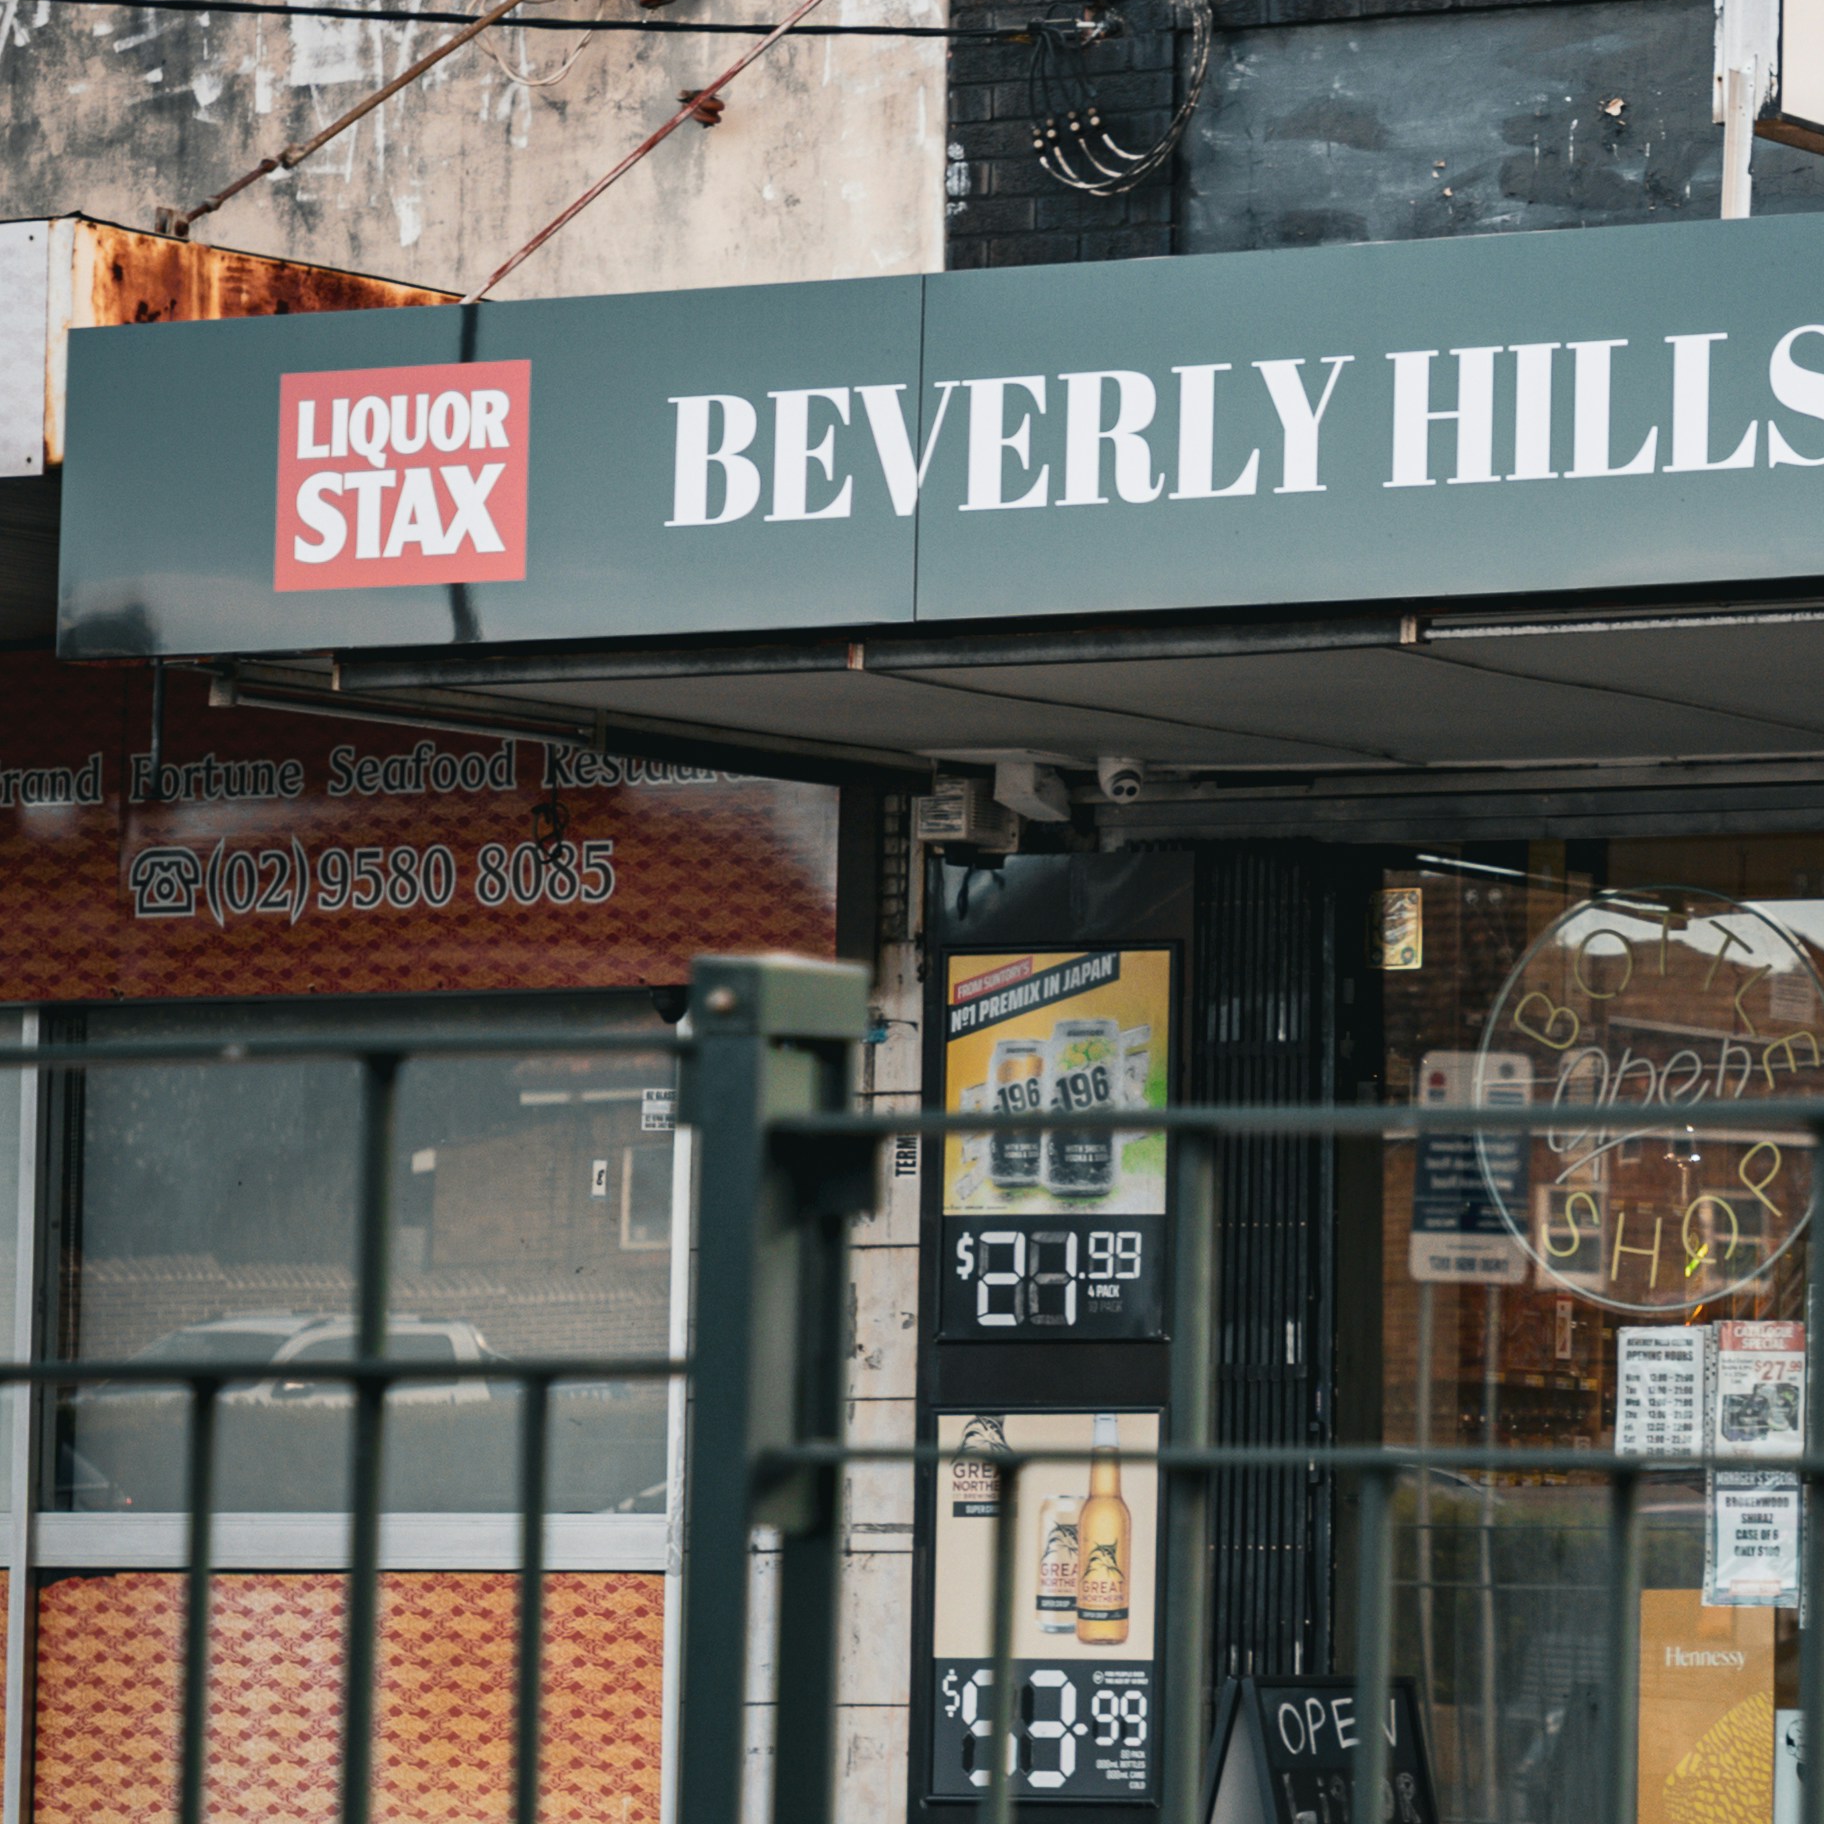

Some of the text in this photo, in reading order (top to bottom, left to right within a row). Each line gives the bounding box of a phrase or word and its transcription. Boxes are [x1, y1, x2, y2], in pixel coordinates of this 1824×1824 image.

[297, 389, 510, 469] LIQUOR
[664, 355, 1355, 527] BEVERLY
[294, 462, 507, 564] STAX
[328, 740, 517, 796] Seafood
[475, 840, 615, 906] 8085
[979, 979, 1041, 1022] PREMIX
[1043, 973, 1060, 999] IN
[1096, 1285, 1120, 1298] PACK
[1735, 1529, 1759, 1540] CASE
[1082, 1581, 1124, 1593] GREAT
[1665, 1646, 1745, 1671] Hennessy
